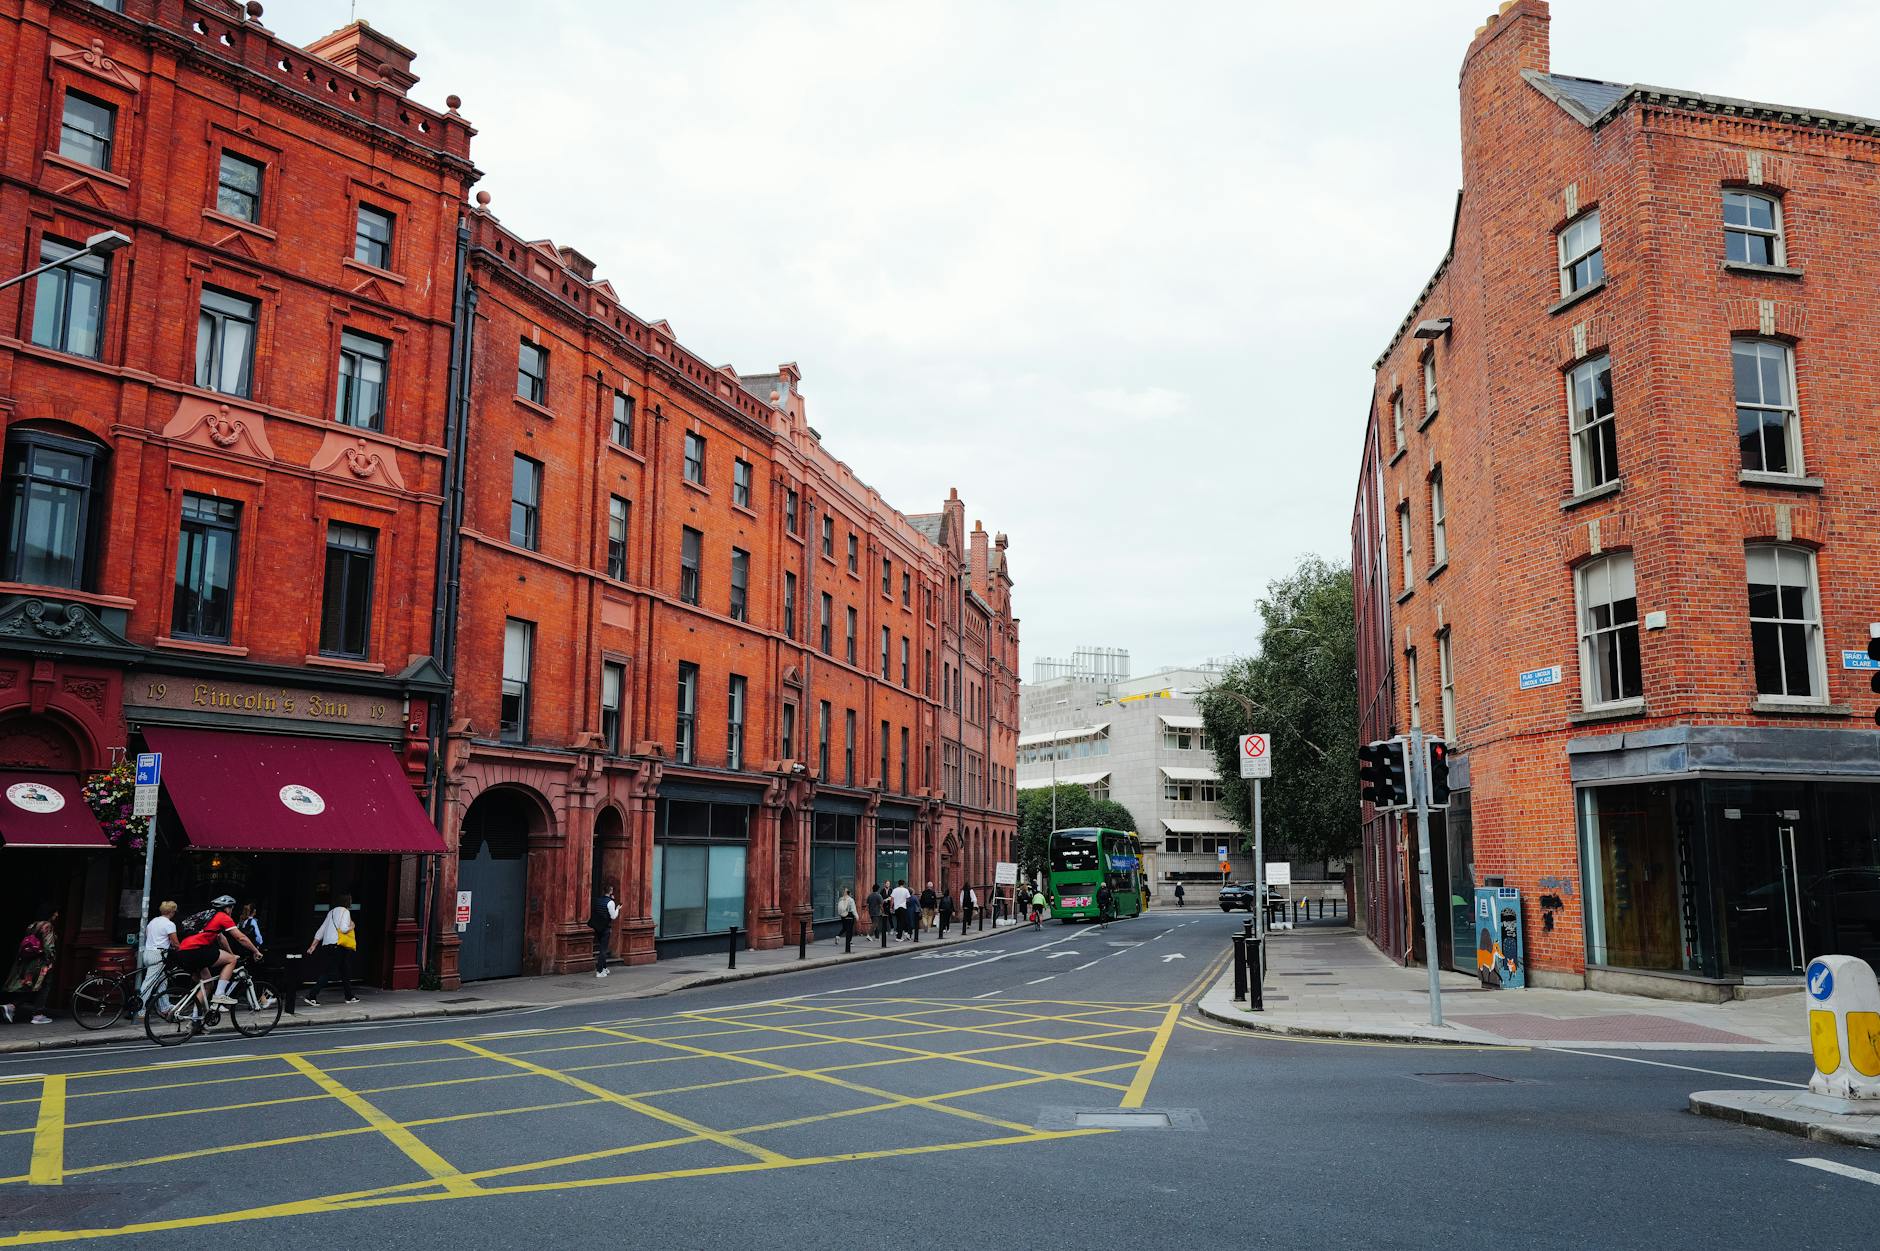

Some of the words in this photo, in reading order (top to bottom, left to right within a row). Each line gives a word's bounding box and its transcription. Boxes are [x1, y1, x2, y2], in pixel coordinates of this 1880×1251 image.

[1540, 676, 1552, 684] PLACE
[147, 683, 168, 700] 19
[192, 683, 296, 713] Lincoln's
[307, 694, 349, 718] Inn
[370, 703, 386, 720] 19
